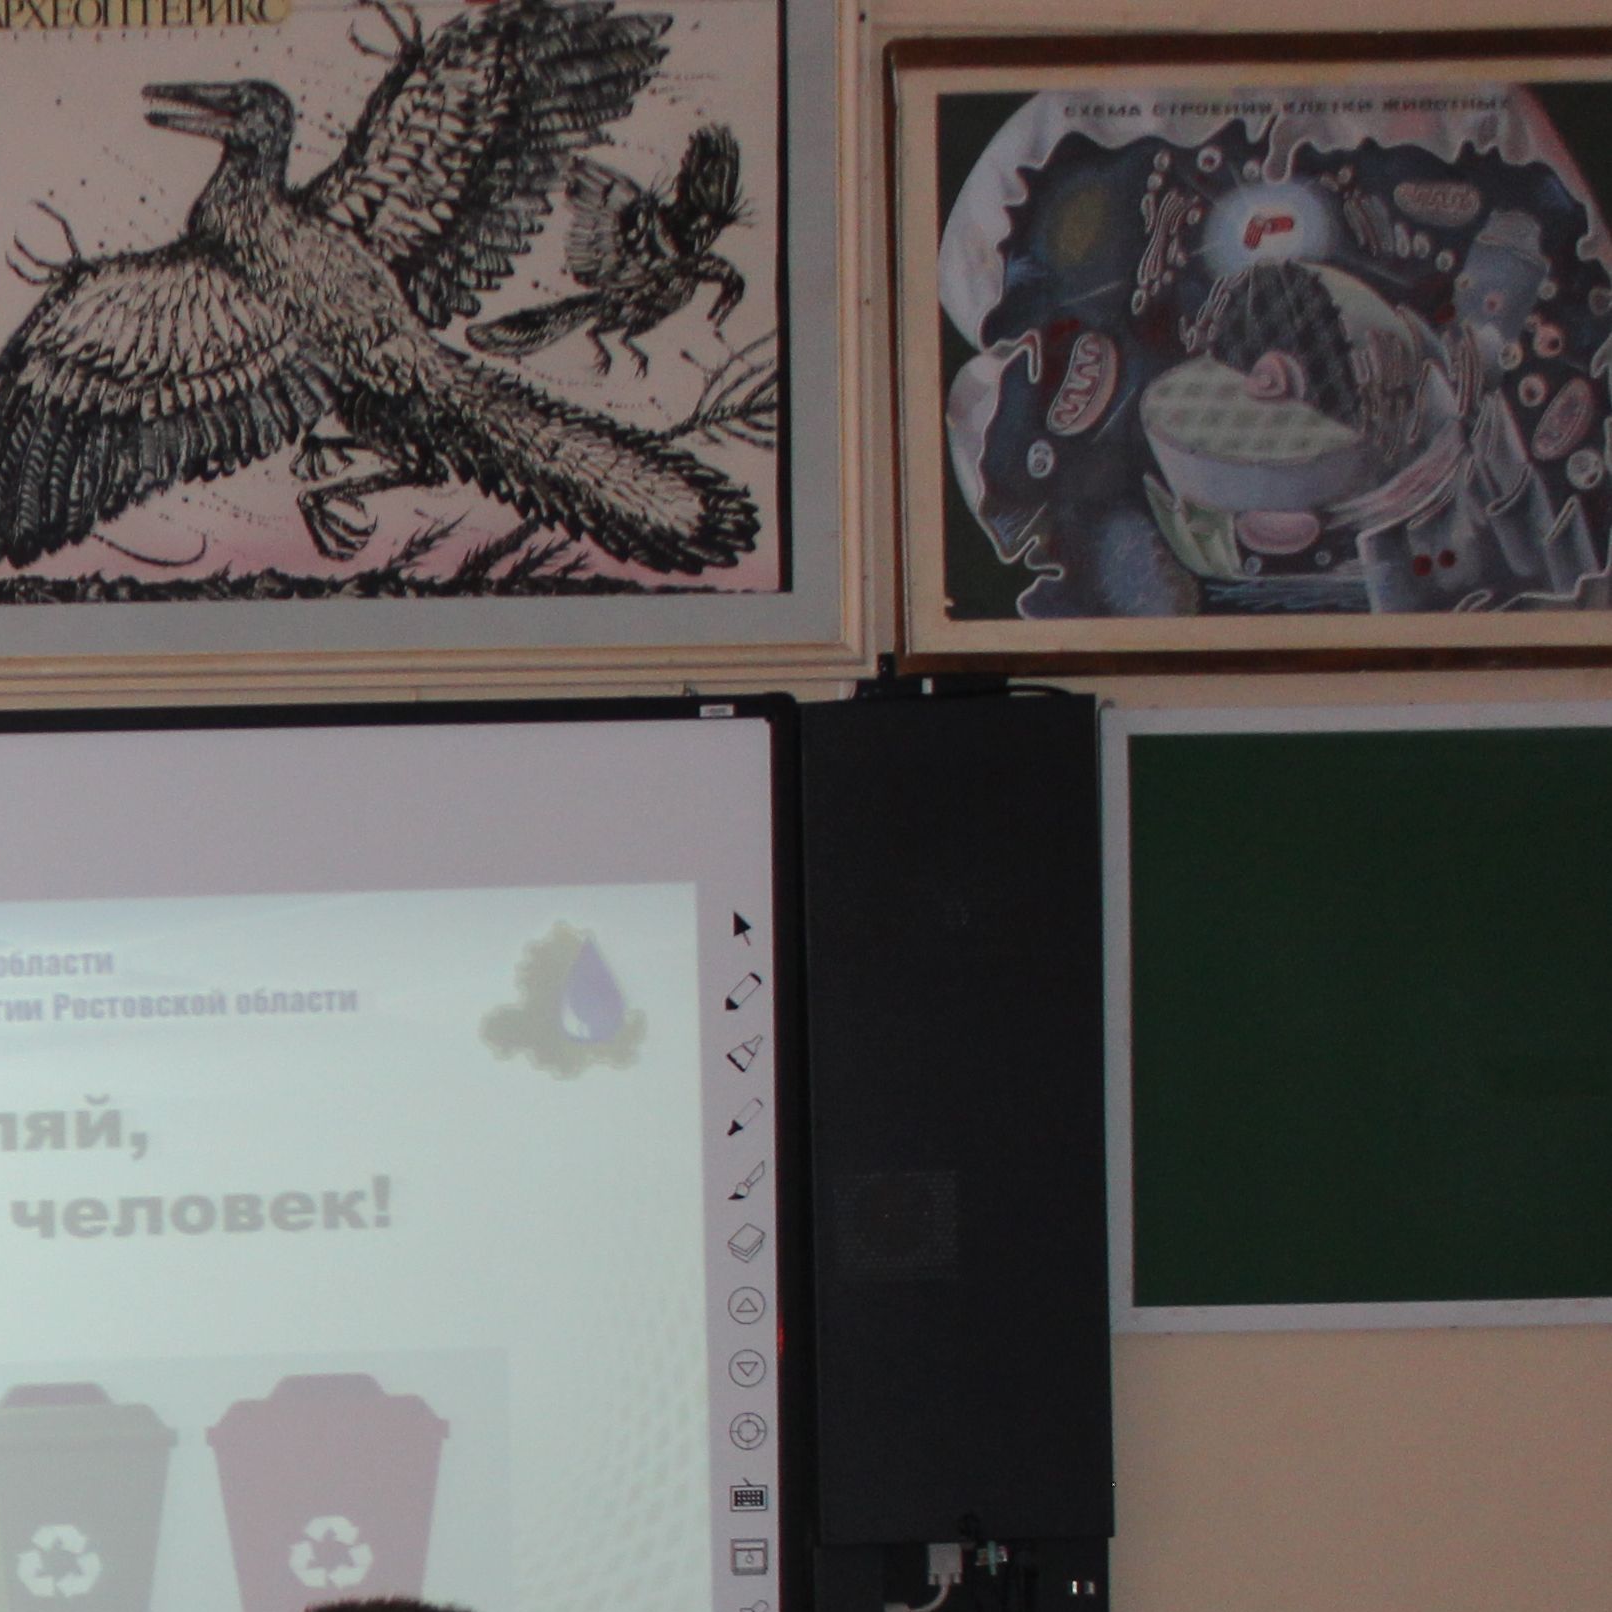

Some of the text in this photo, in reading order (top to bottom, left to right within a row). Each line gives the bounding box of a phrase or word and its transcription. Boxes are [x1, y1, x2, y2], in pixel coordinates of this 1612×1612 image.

[54, 989, 227, 1020] Ростовской
[237, 986, 359, 1015] области
[10, 1174, 394, 1241] человек!
